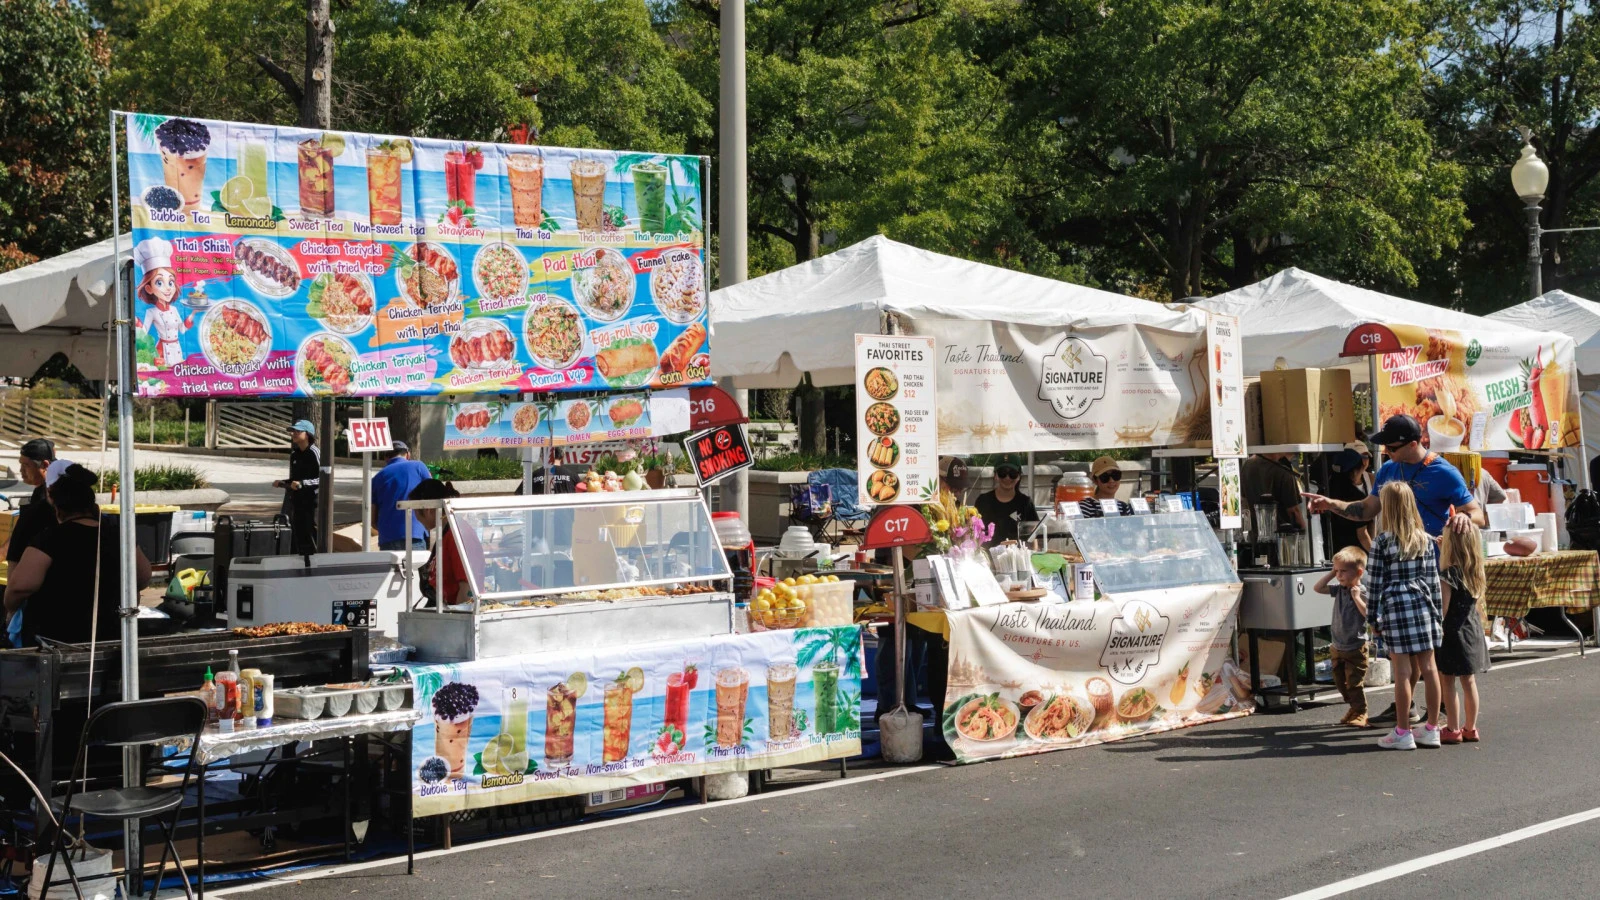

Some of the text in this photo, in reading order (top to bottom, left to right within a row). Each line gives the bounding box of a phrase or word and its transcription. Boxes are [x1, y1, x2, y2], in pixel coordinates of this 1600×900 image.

[192, 212, 210, 224] Tea
[225, 213, 276, 230] Lemonade
[290, 219, 343, 232] Sweet Tea
[353, 222, 425, 236] Non-sweet tea
[438, 224, 484, 238] Strawberry
[516, 228, 550, 240] Thai tea
[580, 230, 624, 243] Thai coffee
[176, 239, 231, 252] Thai Shish
[634, 231, 689, 244] Thai green tea
[301, 242, 382, 256] Chicken teriyaki
[307, 261, 384, 274] with fried rice
[543, 254, 596, 273] Pad thai
[637, 252, 690, 270] Funnel cake
[480, 293, 546, 312] Fried rice vge
[388, 302, 462, 320] Chicken teriyaki
[396, 321, 461, 339] with pad thai
[592, 322, 656, 346] Egg roll vge
[1360, 333, 1382, 346] C18
[867, 348, 924, 361] FAVORITES
[944, 344, 972, 364] Taste
[1382, 345, 1423, 370] CRISPY
[174, 358, 290, 378] Chicken teriyaki with
[352, 355, 428, 373] Chicken teriyaki
[1390, 360, 1448, 384] FRIED CHICKEN
[450, 366, 521, 387] Chicken teriyaki
[530, 370, 586, 386] Roman vge
[660, 364, 706, 384] corn dog
[1044, 372, 1104, 384] SIGNATURE
[182, 376, 293, 394] fried rice and lemon
[358, 376, 380, 389] with
[386, 376, 402, 386] low
[1486, 378, 1520, 402] FRESH
[904, 390, 916, 399] $12
[690, 398, 716, 414] C16
[1492, 391, 1532, 418] SMOOTHIES
[352, 422, 386, 448] EXIT
[607, 427, 646, 438] EGGS ROLL
[904, 424, 916, 433] $12
[446, 438, 470, 446] CHICKEN
[527, 436, 545, 444] RICE
[566, 433, 590, 442] LOMEN
[698, 438, 713, 458] NO
[700, 446, 746, 480] SMOKING
[906, 456, 918, 465] $10
[533, 474, 570, 484] SIGTURE
[906, 488, 918, 496] $10
[884, 517, 908, 533] C17
[334, 610, 344, 622] 7
[990, 606, 1097, 632] Taste Thailand.
[1003, 632, 1081, 648] SIGNATURE BY US.
[1110, 634, 1164, 649] SIGNATURE
[808, 730, 858, 746] Thai green tea
[653, 752, 696, 766] Strawberry
[713, 746, 746, 758] Thai tea
[534, 766, 580, 782] Sweet Tea
[586, 758, 644, 775] Non-sweet tea
[452, 780, 468, 792] Tea
[482, 772, 523, 790] Lemonade
